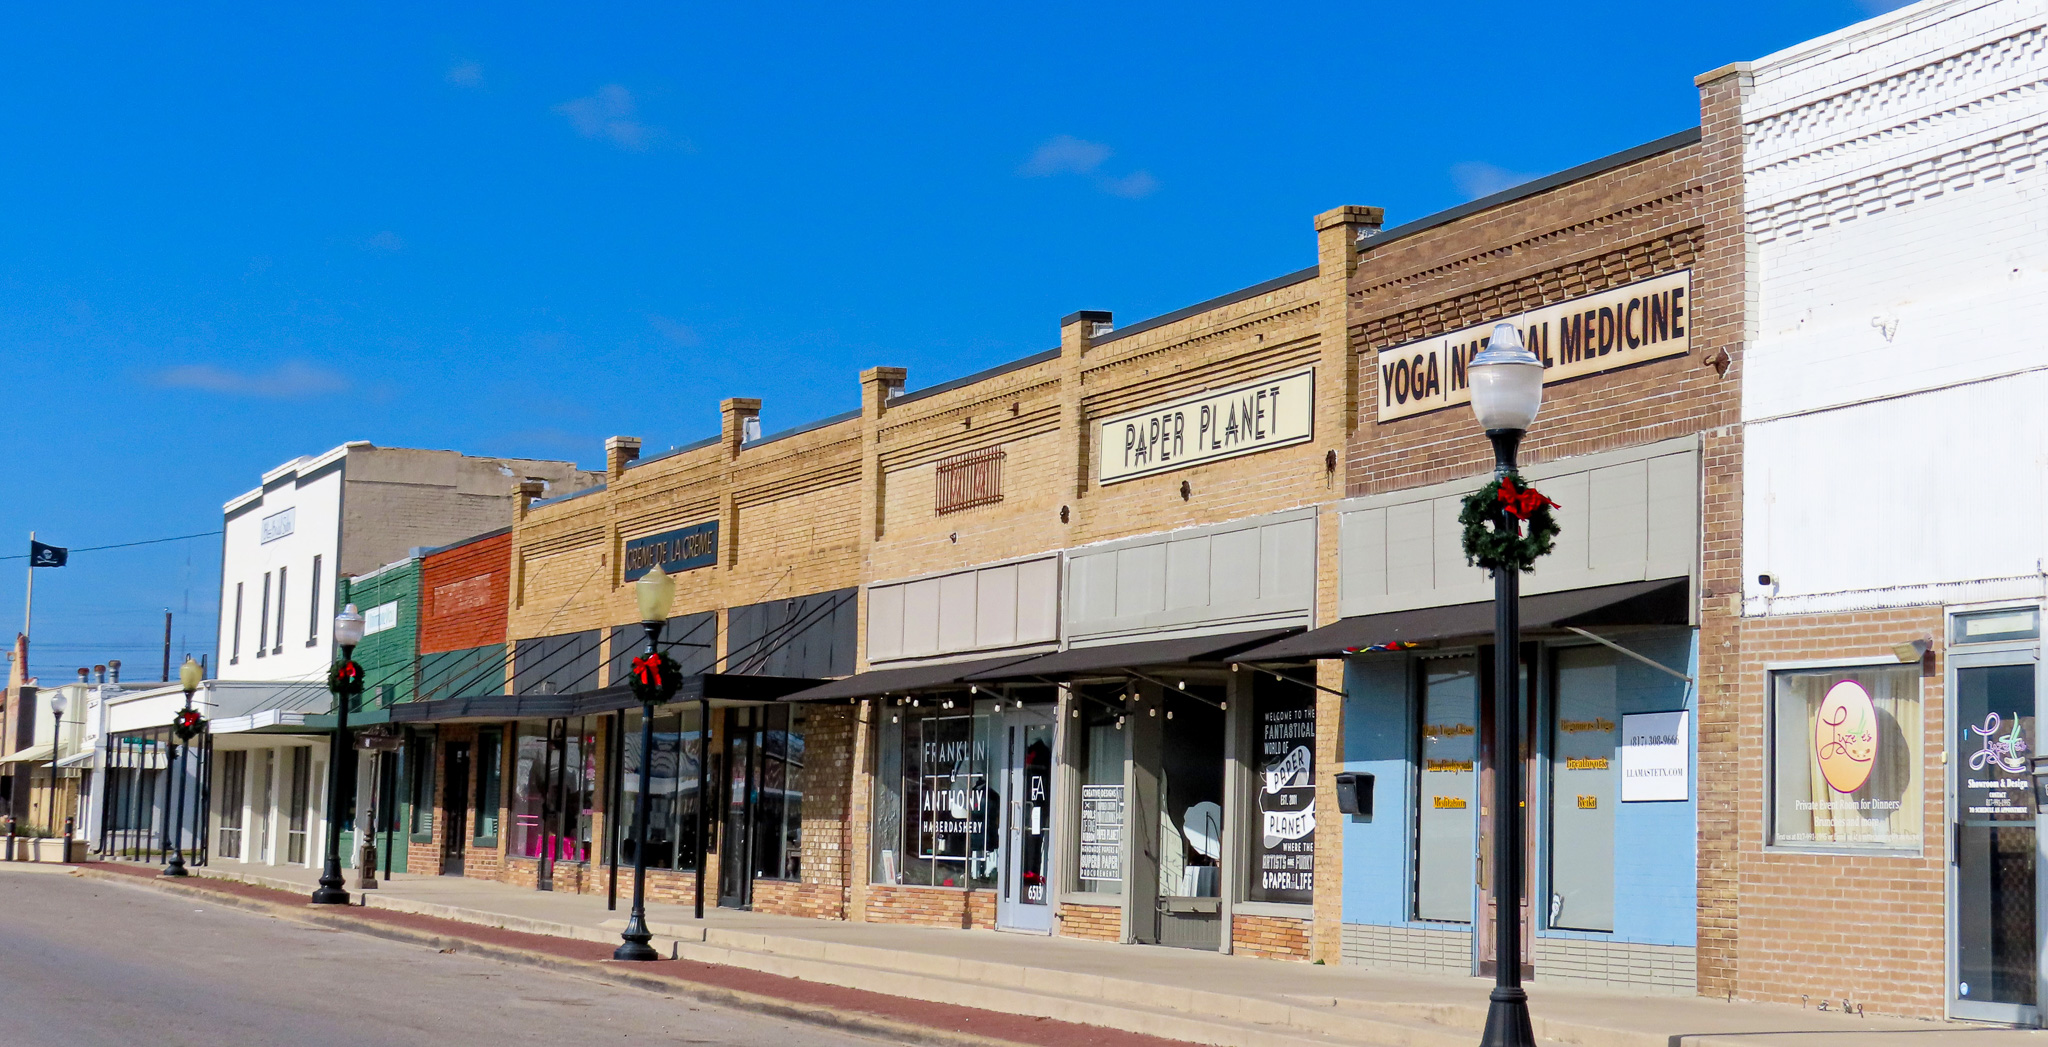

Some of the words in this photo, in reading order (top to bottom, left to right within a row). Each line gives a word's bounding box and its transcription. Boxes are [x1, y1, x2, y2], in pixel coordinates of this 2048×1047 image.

[1382, 352, 1440, 407] YOGA
[1561, 287, 1685, 364] MEDICINE
[1125, 411, 1185, 468] PAPER
[1199, 386, 1280, 452] PLANET
[656, 542, 667, 564] DE
[671, 539, 681, 562] LA
[1265, 710, 1292, 721] WELCOME
[1295, 710, 1302, 719] TO
[1304, 709, 1315, 718] THE
[1264, 722, 1315, 739] FANTASTICAL
[925, 741, 985, 762] FRANKLIN
[1264, 741, 1281, 754] WORLD
[1282, 741, 1289, 754] OF
[950, 769, 956, 782] &
[1274, 749, 1304, 790] PAPER
[1626, 768, 1683, 777] LLAMASTETX.COM
[1968, 779, 1999, 788] Showroom
[2000, 778, 2006, 788] &
[2006, 778, 2028, 790] Design
[1083, 788, 1100, 797] CREATIVE
[924, 790, 983, 811] ANTHONY
[1795, 800, 1818, 810] Private
[1820, 799, 1838, 810] Event
[1839, 799, 1859, 810] Room
[1860, 798, 1871, 810] for
[1872, 798, 1899, 810] Dinners
[923, 822, 983, 833] HABERDASHERY
[1270, 814, 1306, 835] PLANET
[1283, 842, 1301, 852] WHERE
[1303, 842, 1313, 852] THE
[1101, 855, 1118, 869] PAPER
[1262, 854, 1287, 869] ARTISTS
[1295, 854, 1313, 869] FUNKY
[1262, 871, 1268, 889] &
[1268, 872, 1291, 889] PAPER
[1295, 873, 1312, 890] LIFE
